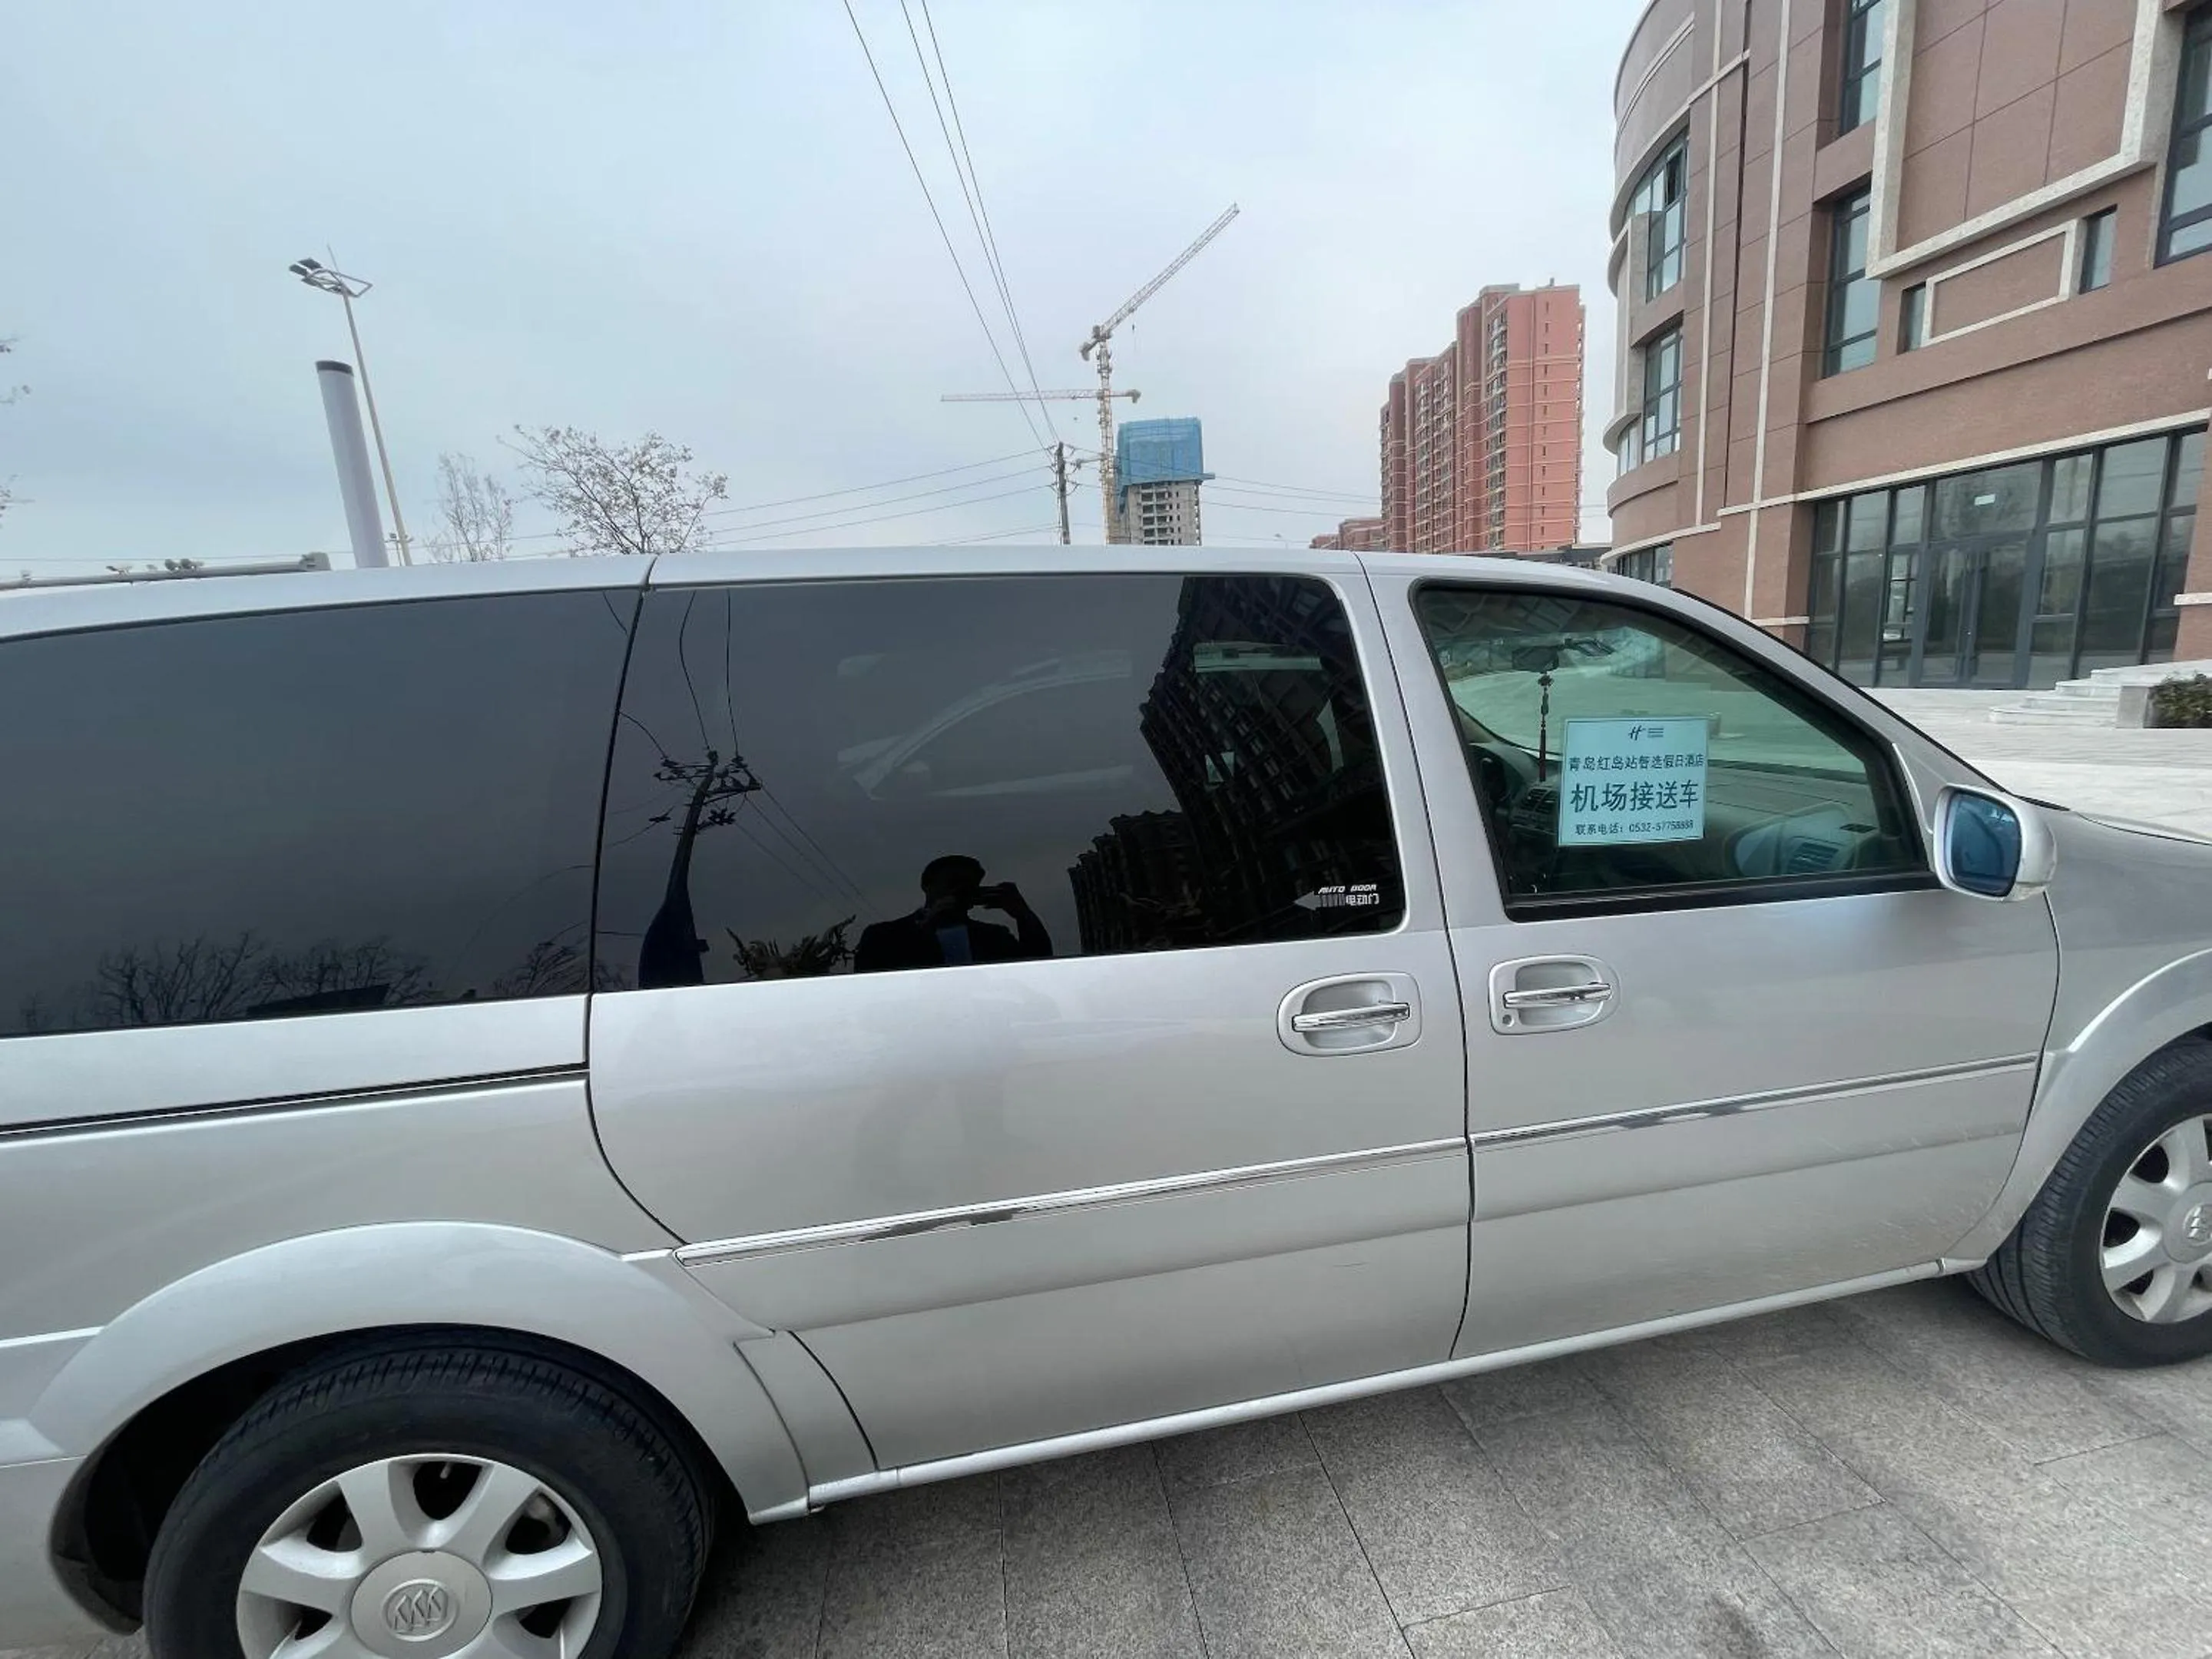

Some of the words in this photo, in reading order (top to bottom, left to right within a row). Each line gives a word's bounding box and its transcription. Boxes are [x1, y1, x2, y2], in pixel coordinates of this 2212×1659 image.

[1569, 753, 1704, 771] 青岛红岛站智选假日酒店
[1570, 780, 1698, 813] 机场接送车
[1318, 886, 1346, 894] AUTO
[1350, 884, 1377, 892] DOOR
[1346, 893, 1380, 906] 电动门
